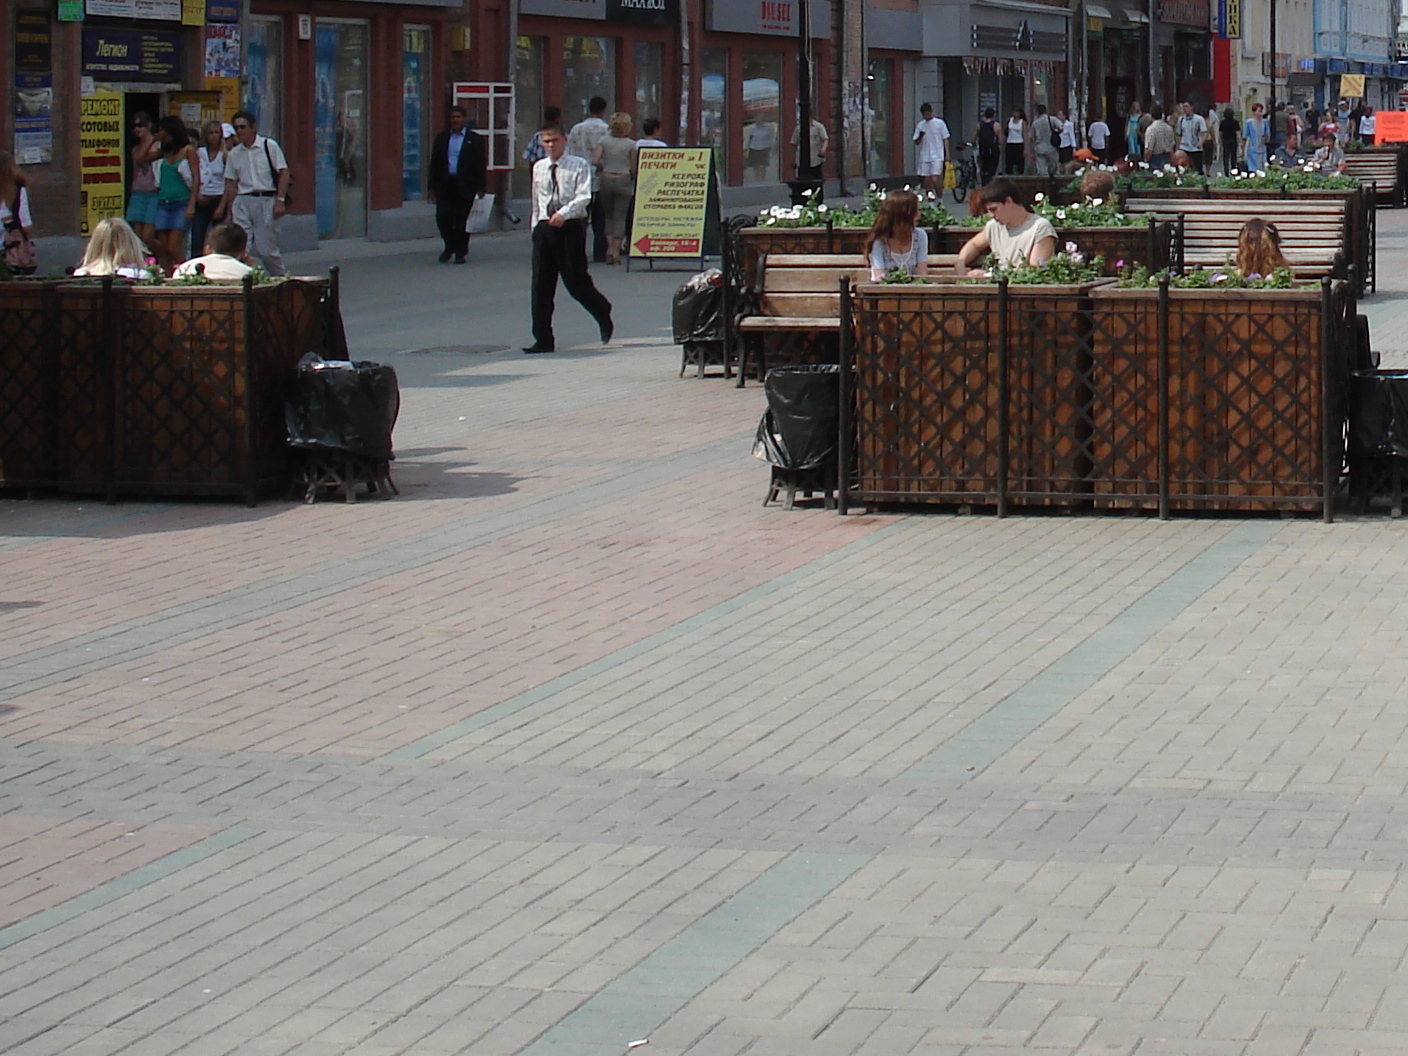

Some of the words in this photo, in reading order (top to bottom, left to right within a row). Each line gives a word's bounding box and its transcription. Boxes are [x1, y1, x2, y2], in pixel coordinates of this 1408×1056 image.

[761, 1, 791, 21] DIESEL
[81, 99, 120, 115] РЕМОНТ
[81, 121, 120, 132] СОТОВЫХ
[81, 138, 120, 149] ТЕЛЕФОНОВ
[641, 152, 685, 160] ВИЗИТКИ
